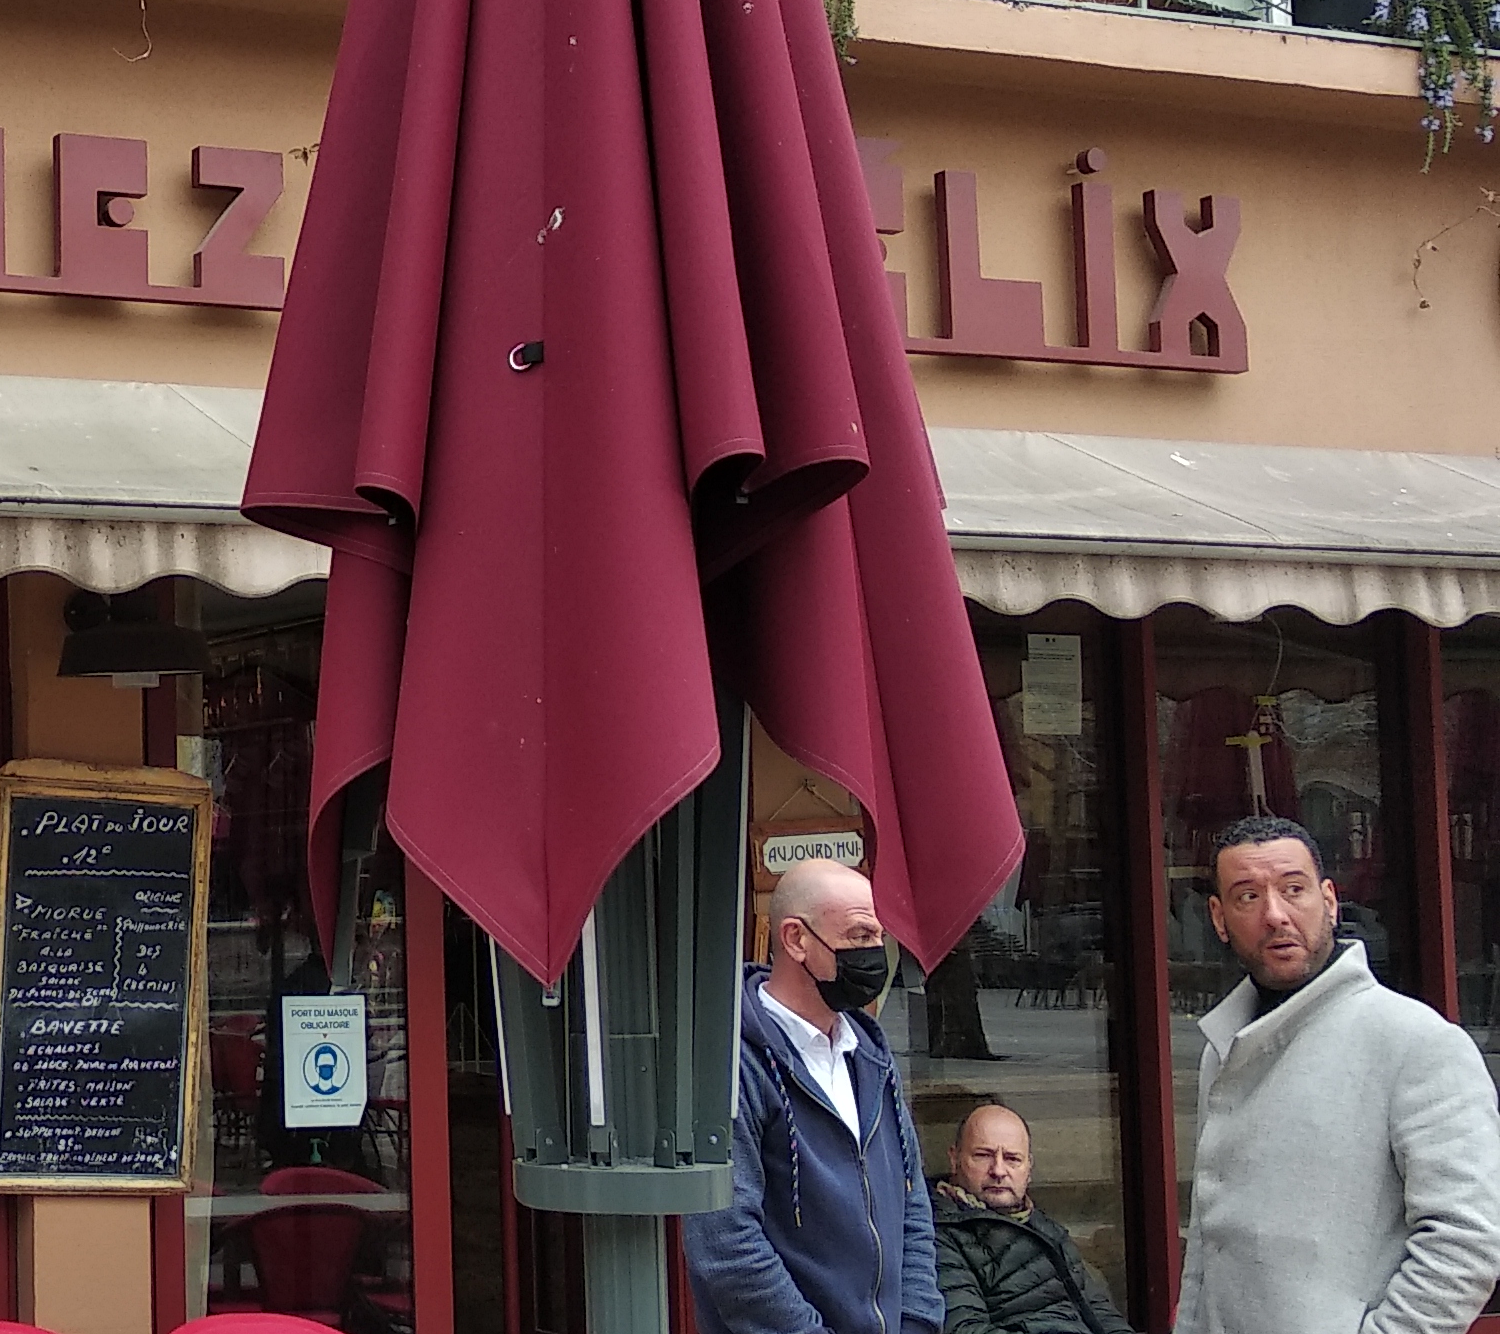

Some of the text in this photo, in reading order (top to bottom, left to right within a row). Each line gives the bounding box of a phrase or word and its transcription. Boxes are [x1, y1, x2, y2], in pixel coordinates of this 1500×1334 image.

[35, 811, 104, 836] PLAT
[128, 808, 190, 834] JOUR
[135, 890, 183, 904] ORIGINE
[31, 905, 108, 921] MORUE
[136, 944, 162, 959] DES
[16, 961, 105, 974] BASQUAISE
[123, 978, 177, 993] CHEMINS
[290, 1008, 359, 1018] PORT DU MASQUE
[300, 1021, 350, 1030] OBLIGATOIRE
